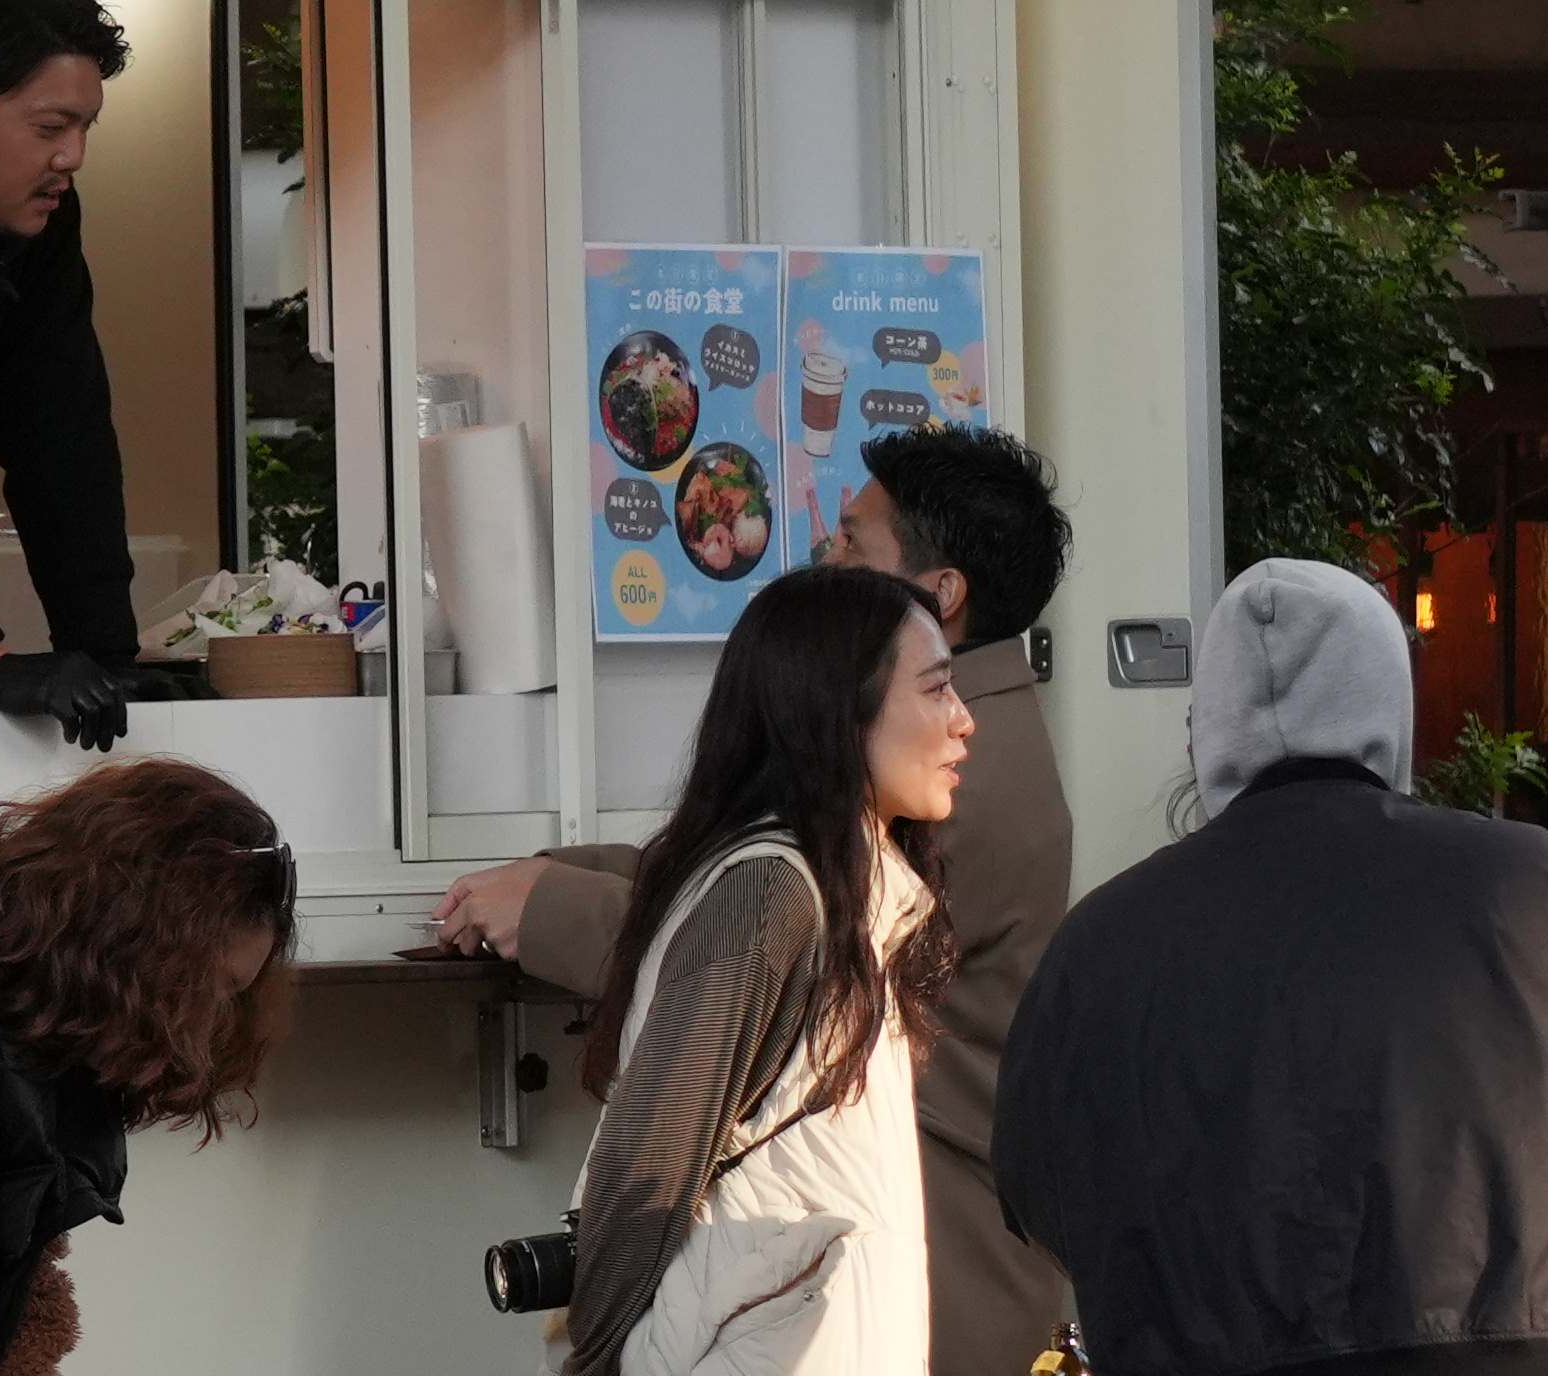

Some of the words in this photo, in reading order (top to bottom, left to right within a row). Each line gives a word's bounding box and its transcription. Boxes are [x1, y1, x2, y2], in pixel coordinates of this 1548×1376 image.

[629, 288, 744, 315] この街の食堂
[832, 290, 882, 312] drink
[889, 293, 939, 313] menu
[932, 365, 959, 381] 300円
[865, 400, 926, 415] ホットココア
[627, 566, 648, 578] ALL
[619, 582, 658, 605] 600円
